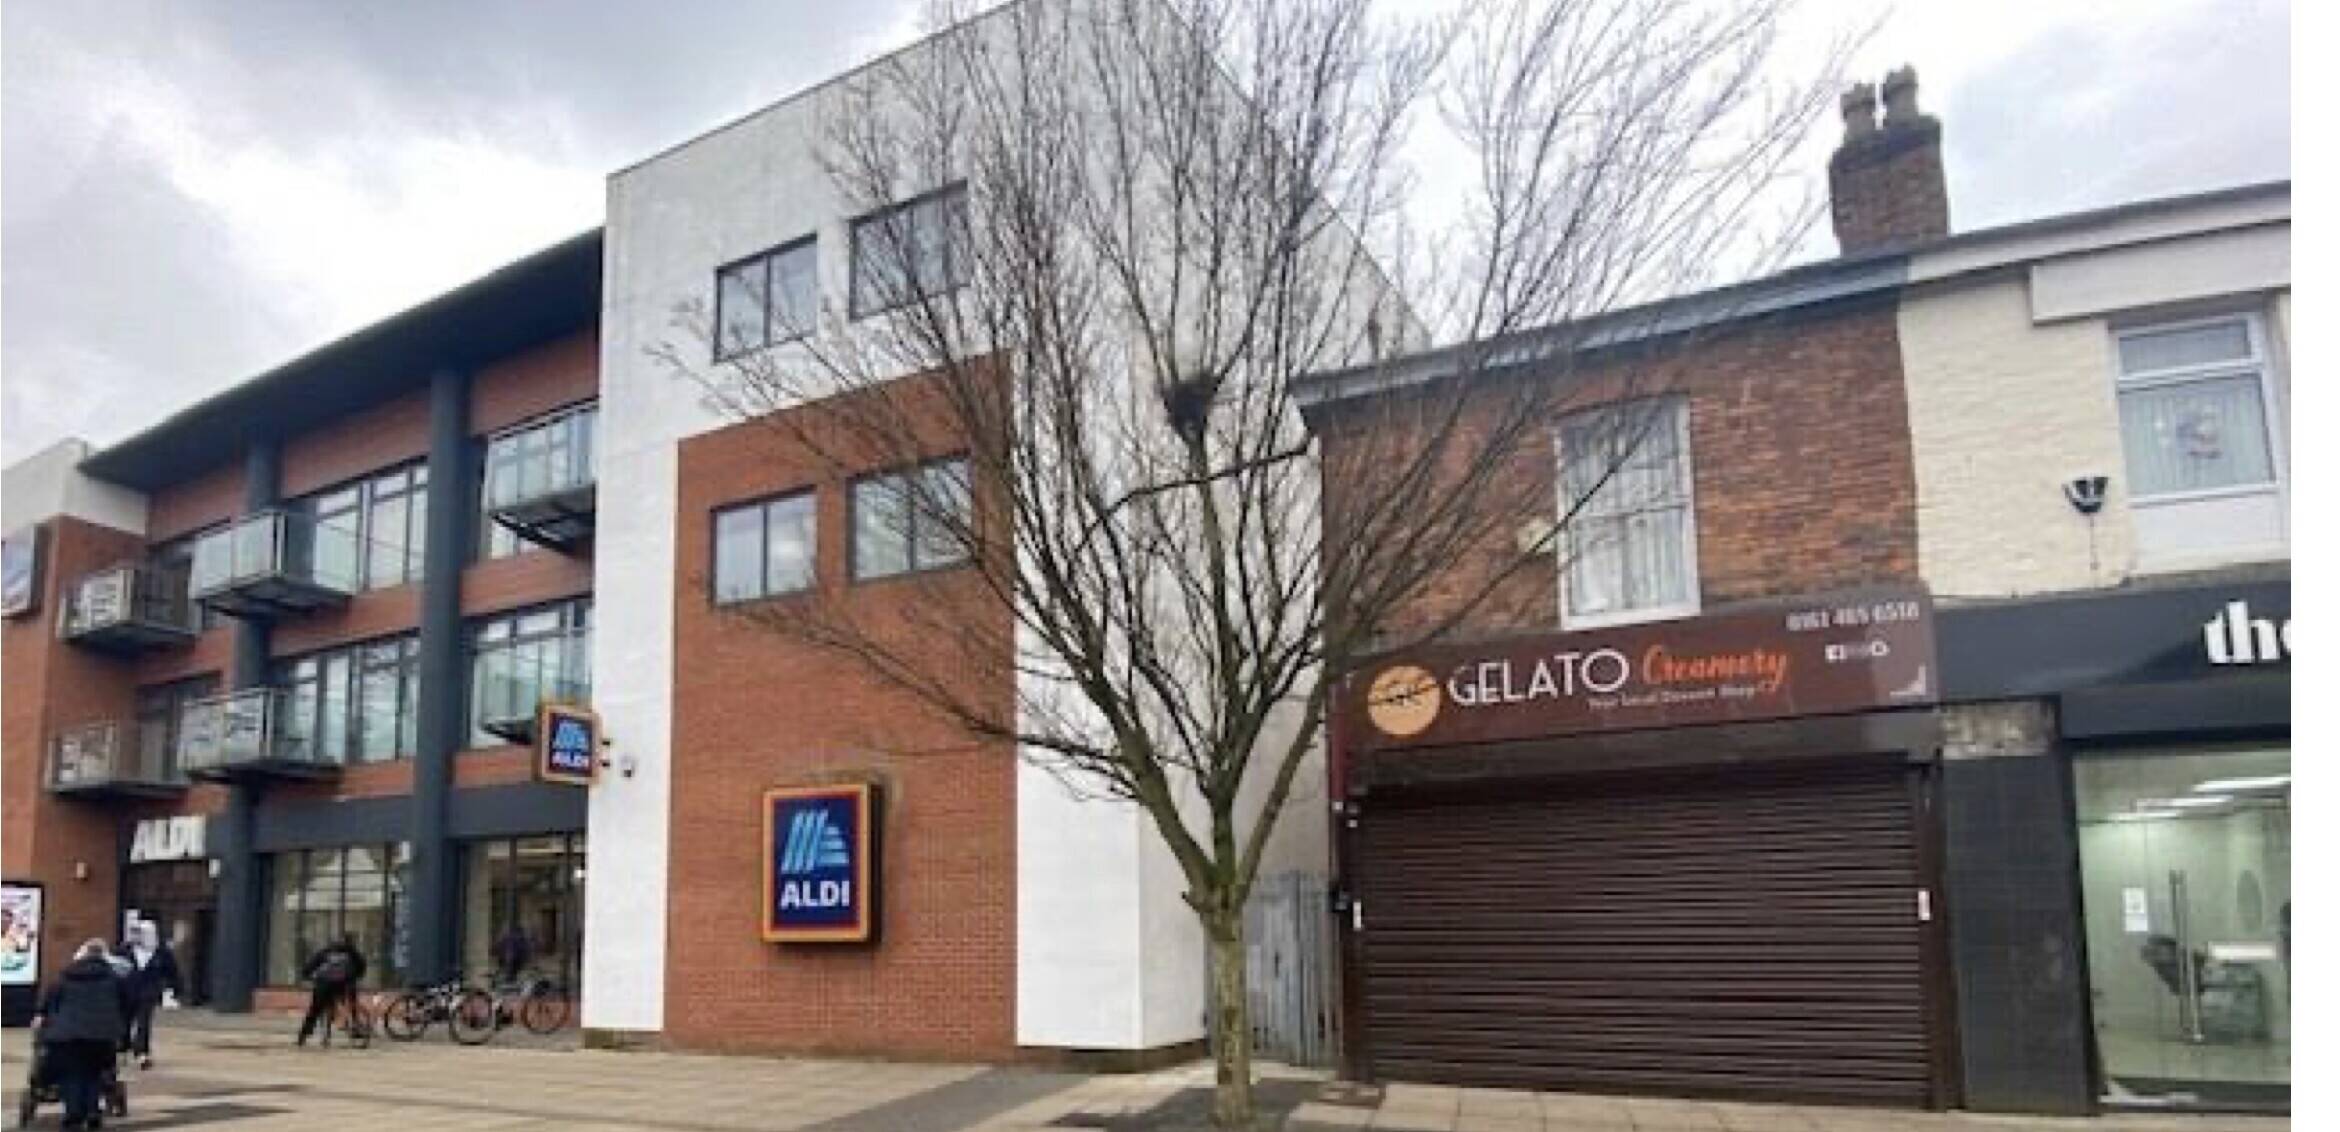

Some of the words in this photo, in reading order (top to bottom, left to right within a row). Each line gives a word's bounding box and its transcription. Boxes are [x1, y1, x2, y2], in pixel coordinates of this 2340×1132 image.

[1448, 648, 1630, 705] GELATO
[1642, 645, 1788, 693] Creamery
[552, 752, 590, 769] ALDI
[130, 815, 206, 864] ALDI
[780, 880, 850, 910] ALDI
